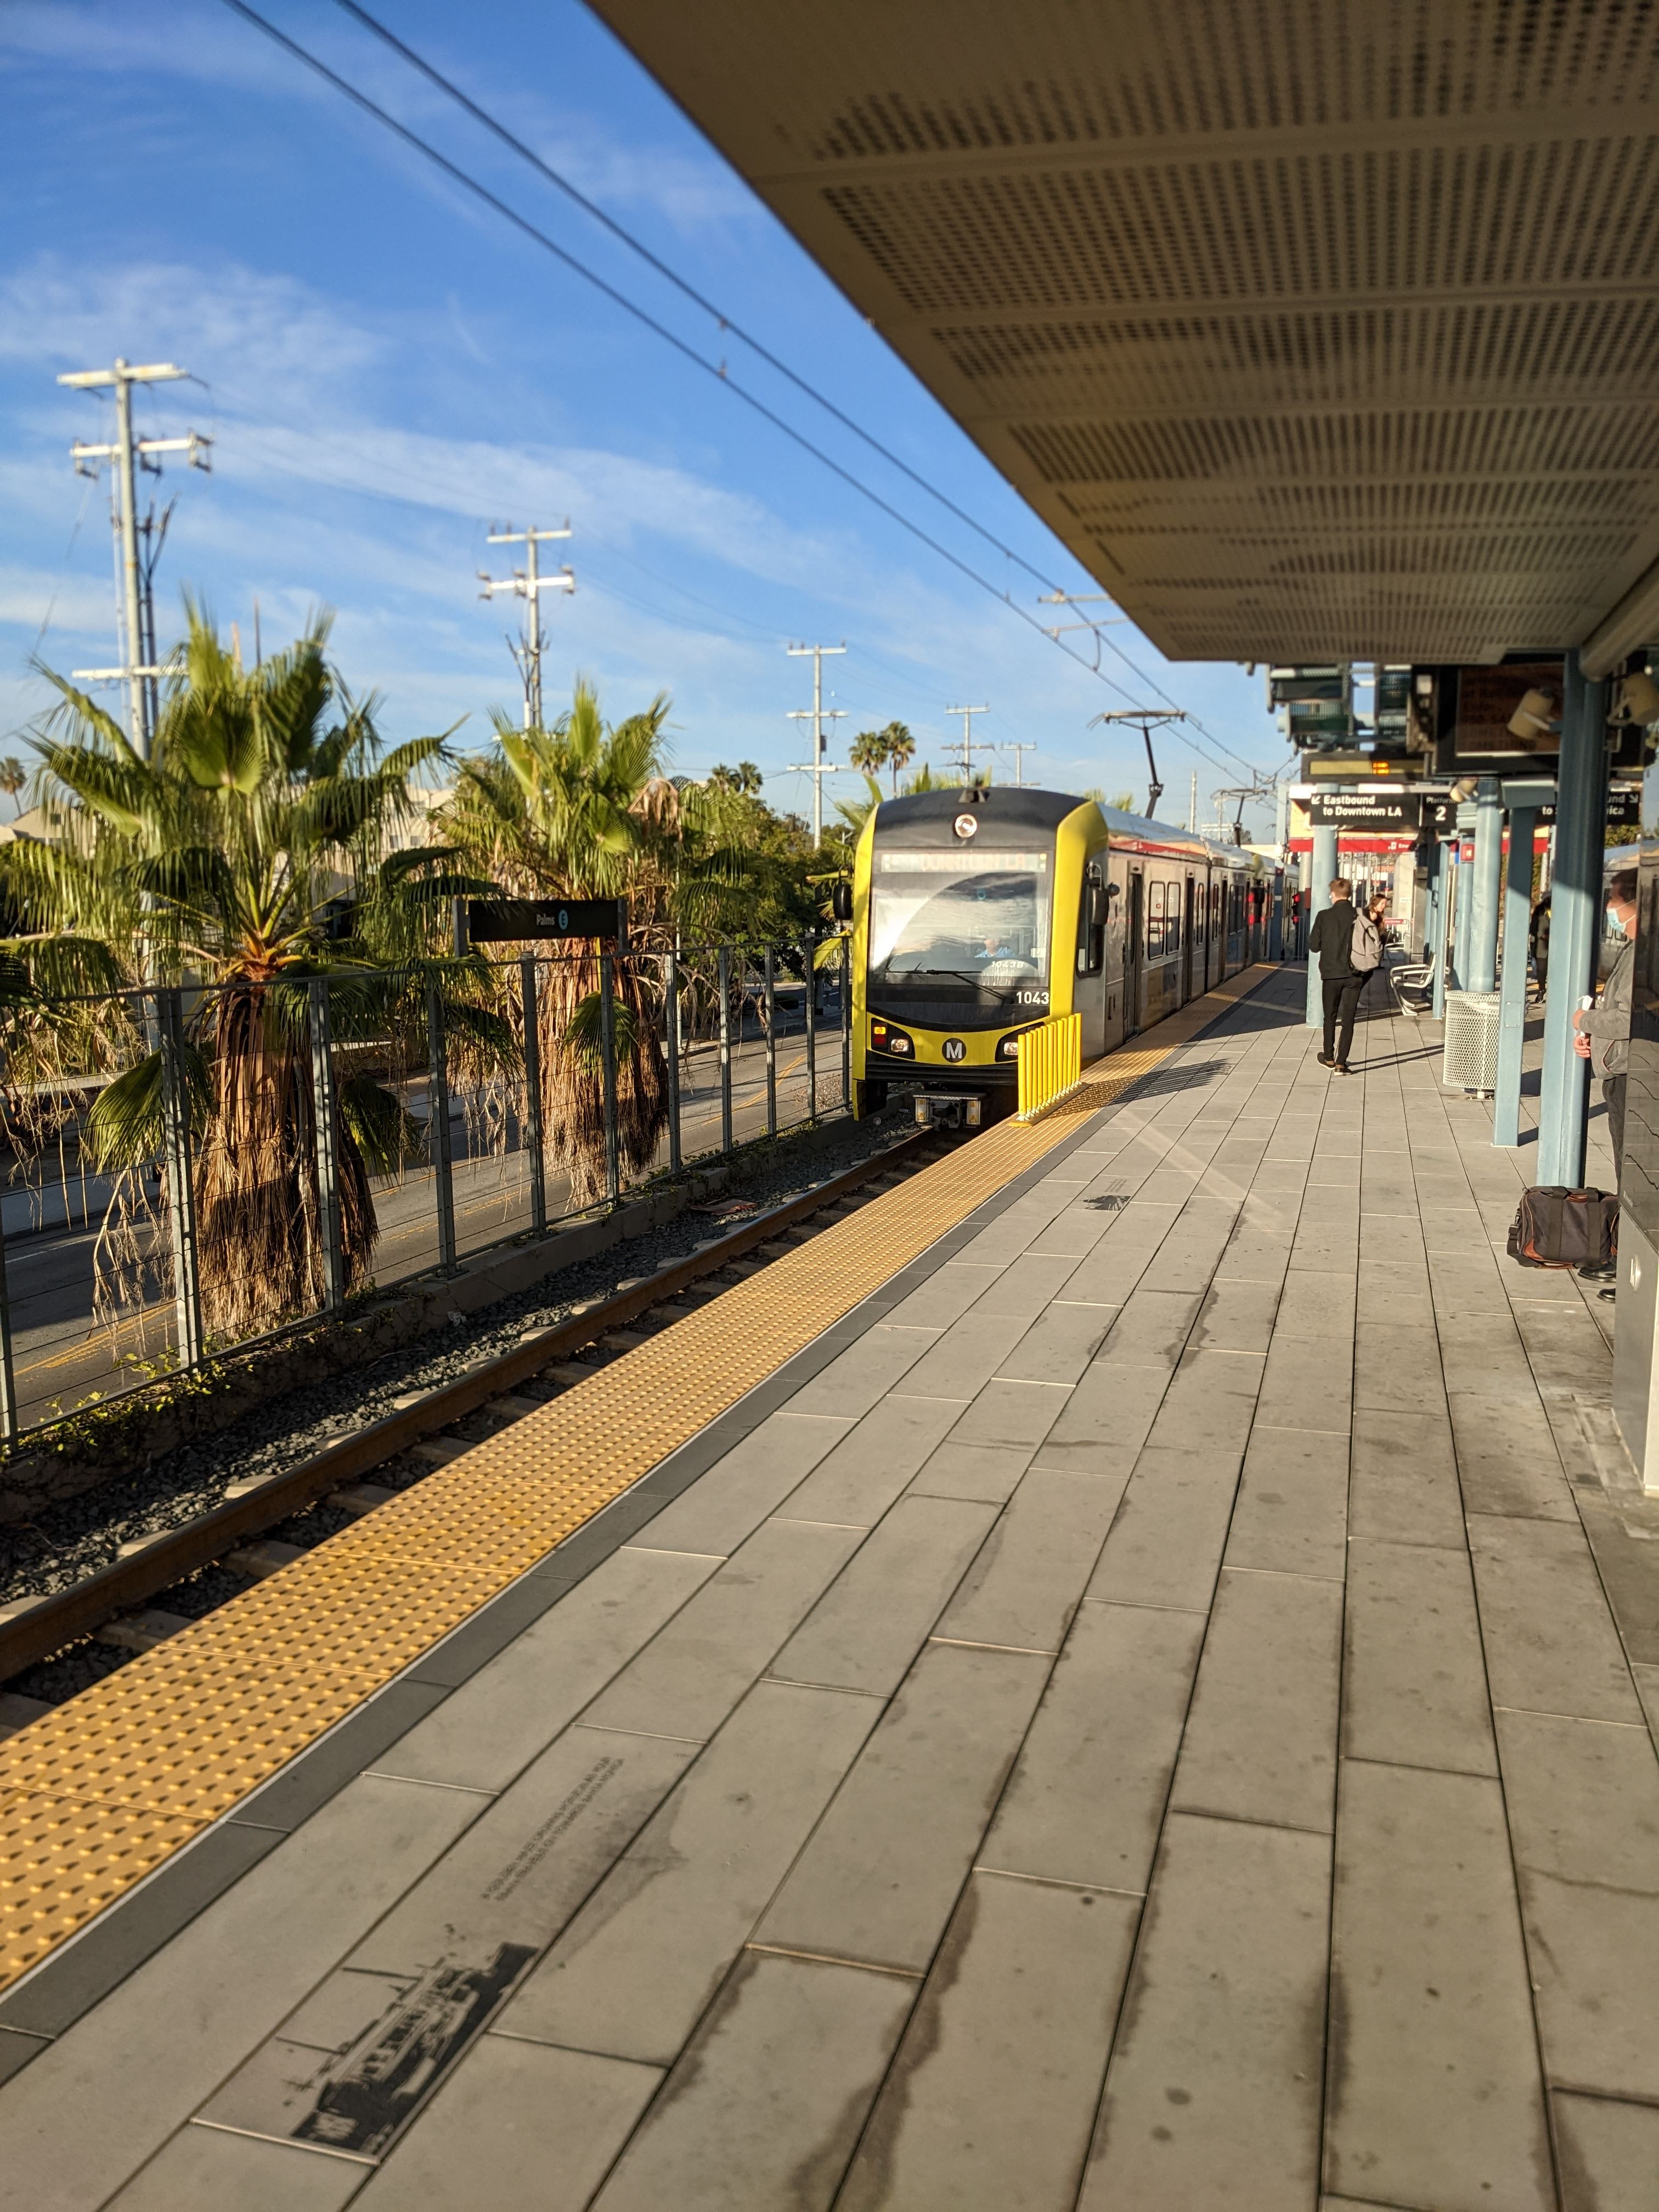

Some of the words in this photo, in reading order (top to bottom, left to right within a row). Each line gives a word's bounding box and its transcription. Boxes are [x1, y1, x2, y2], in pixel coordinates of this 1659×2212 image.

[1323, 795, 1375, 805] Eastbound
[1323, 806, 1333, 816] to
[1335, 806, 1386, 816] Downtown
[1387, 807, 1402, 816] LA
[1435, 806, 1446, 821] 2
[1542, 806, 1553, 815] to
[921, 853, 1001, 871] DOWNTOWN
[1005, 853, 1026, 871] LA
[536, 913, 555, 926] Palms
[1016, 991, 1049, 1005] 1043
[946, 1042, 962, 1059] M
